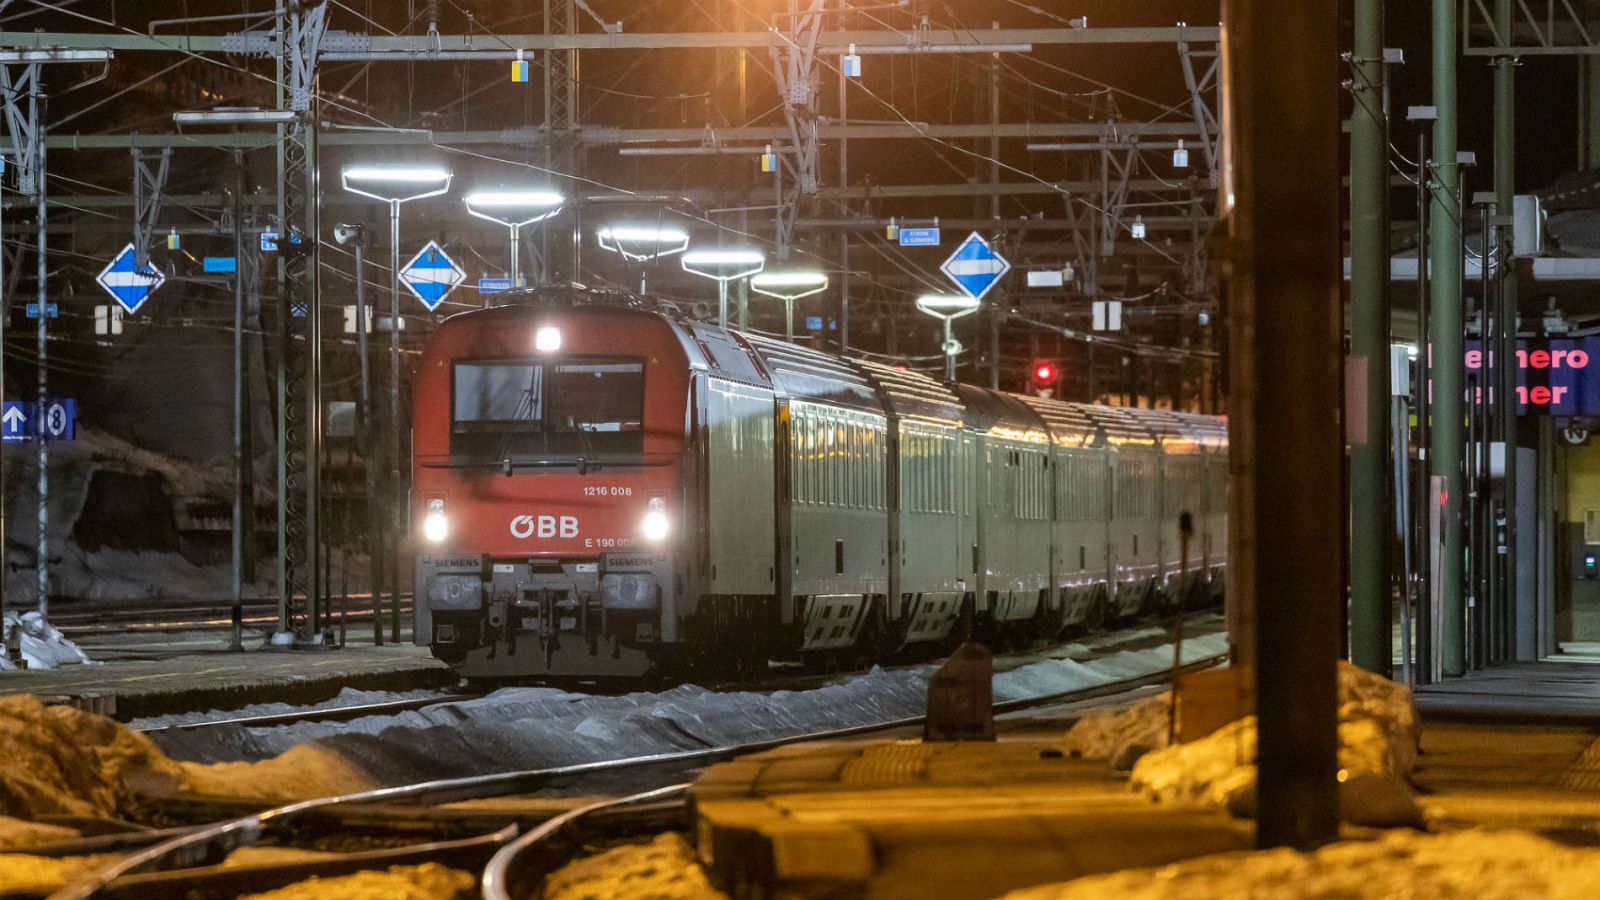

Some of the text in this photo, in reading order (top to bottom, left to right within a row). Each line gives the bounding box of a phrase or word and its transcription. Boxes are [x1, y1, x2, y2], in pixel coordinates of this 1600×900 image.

[52, 409, 62, 430] 8
[583, 486, 633, 496] 1216 008
[509, 515, 580, 539] ÖBB
[584, 538, 593, 548] E
[597, 538, 615, 548] 190
[434, 559, 480, 568] SIEMENS
[608, 558, 655, 568] SIEMENS
